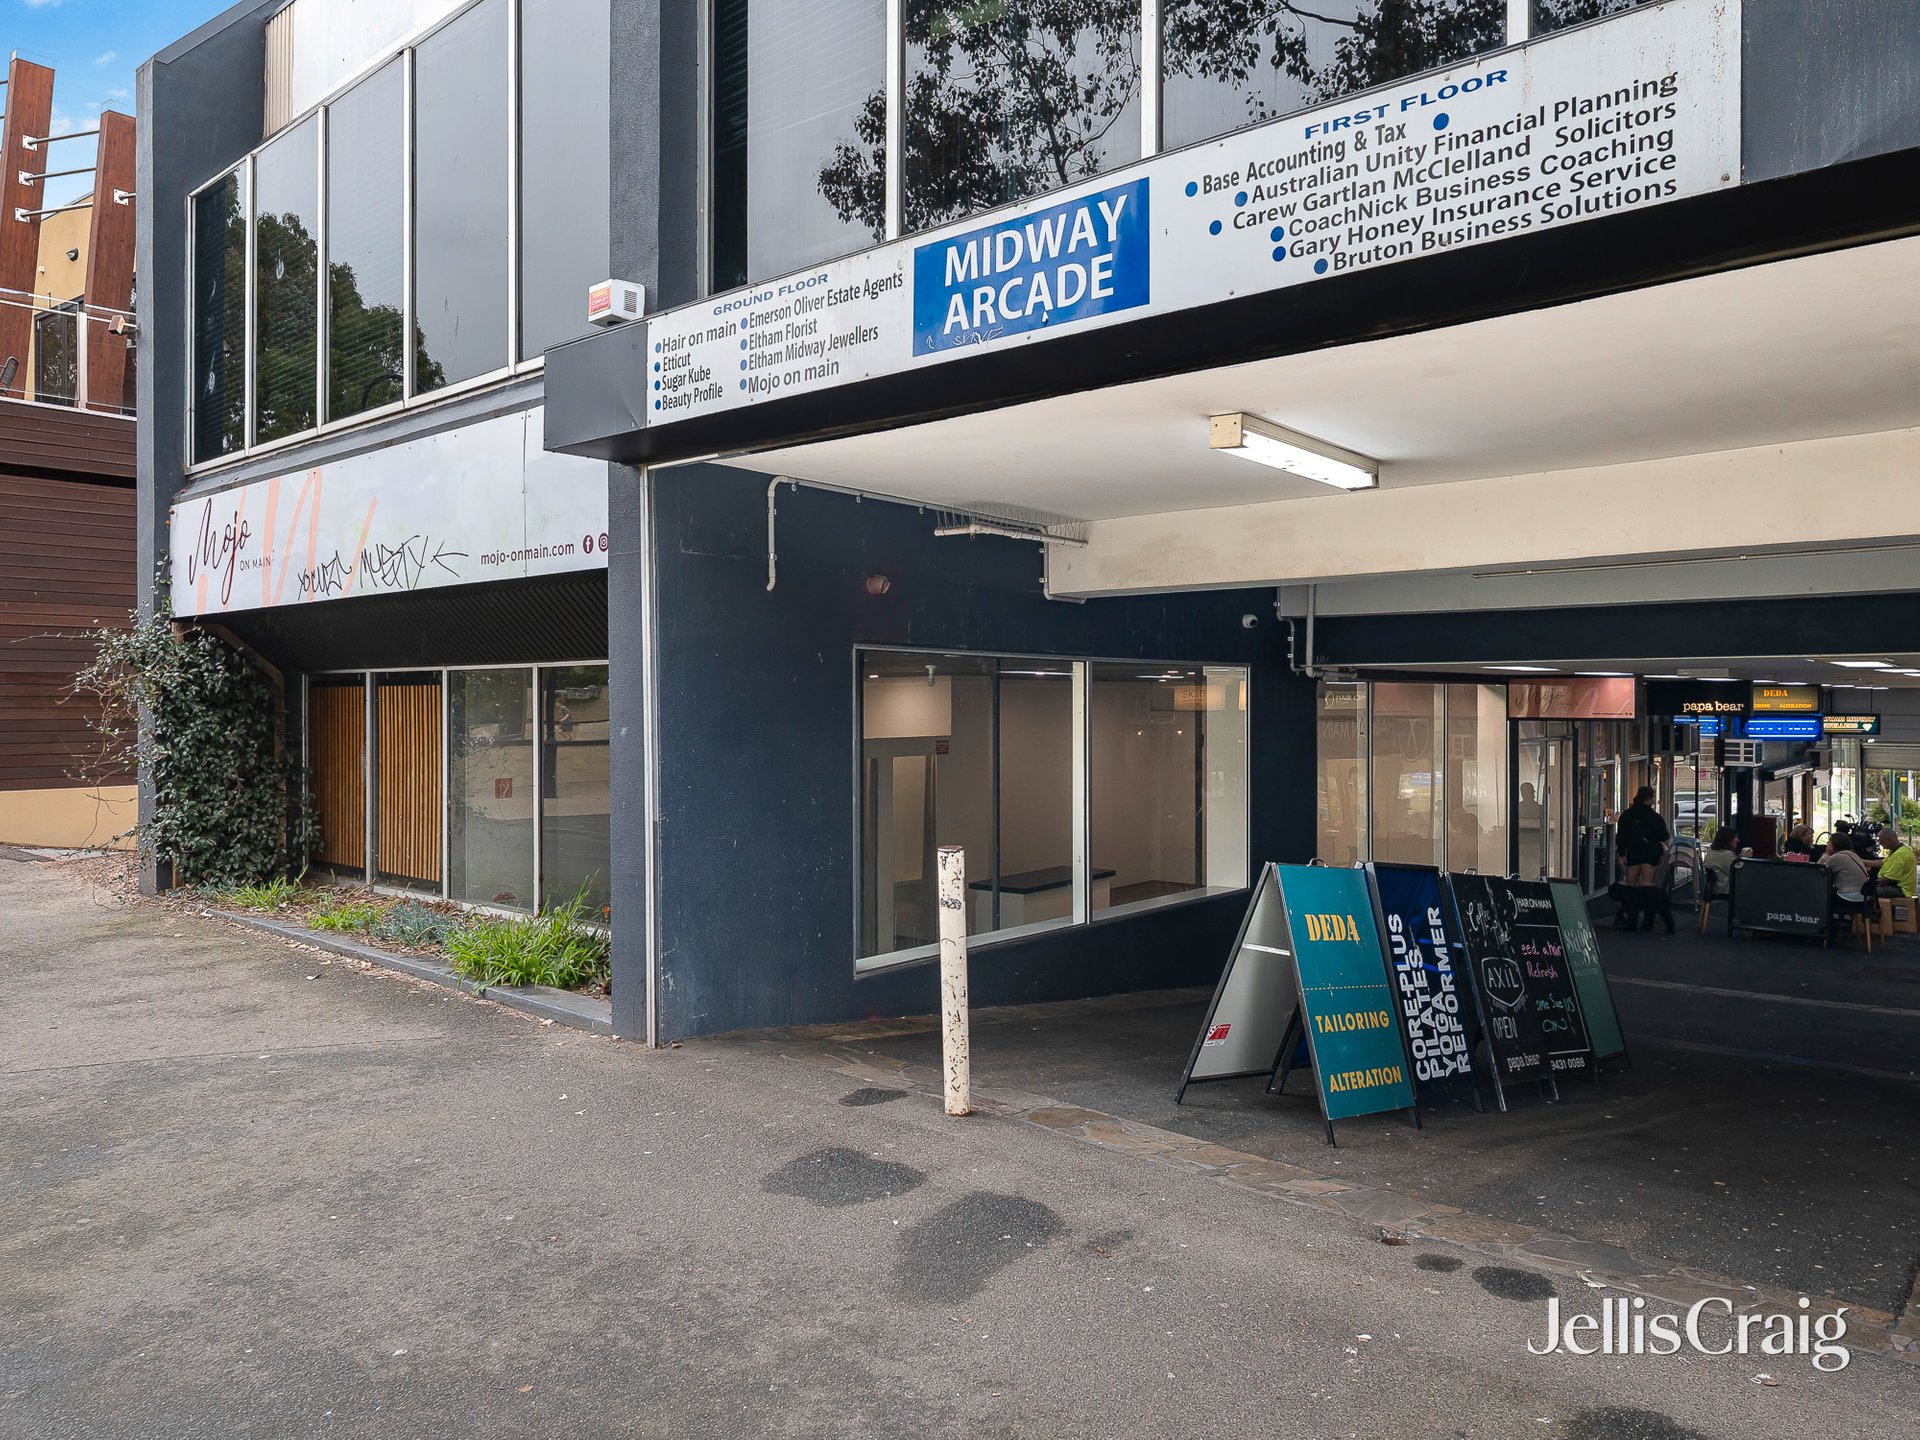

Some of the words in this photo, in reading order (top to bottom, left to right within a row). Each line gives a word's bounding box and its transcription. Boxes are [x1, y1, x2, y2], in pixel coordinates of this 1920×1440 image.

[1304, 103, 1390, 140] FIRST
[1400, 69, 1508, 112] FLOOR
[1251, 162, 1359, 204] Australian
[1365, 143, 1428, 174] Unity
[1433, 105, 1546, 156] Financial
[1553, 71, 1679, 123] Planning
[1202, 169, 1240, 196] Base
[1245, 139, 1346, 184] Accounting
[1353, 130, 1368, 152] &
[1374, 122, 1407, 147] Tax
[1233, 202, 1298, 230] Carew
[1302, 178, 1386, 213] Gartlan
[1393, 134, 1531, 190] McClelland
[1555, 101, 1677, 148] Solicitors
[1288, 193, 1408, 237] CoachNick
[1416, 166, 1531, 208] Business
[1539, 128, 1675, 176] Coaching
[1289, 233, 1341, 260] Gary
[1347, 214, 1424, 246] Honey
[1432, 182, 1562, 227] Insurance
[1569, 153, 1677, 194] Service
[1333, 239, 1413, 272] Bruton
[1421, 212, 1532, 251] Business
[1540, 178, 1678, 225] Solutions
[944, 193, 1128, 288] MIDWAY
[713, 290, 774, 316] GROUND
[778, 273, 829, 298] FLOOR
[749, 304, 792, 329] Emerson
[794, 295, 825, 317] Oliver
[827, 284, 861, 308] Estate
[863, 272, 903, 300] Agents
[942, 252, 1115, 336] ARCADE
[662, 334, 686, 354] Hair
[688, 331, 703, 347] on
[706, 320, 737, 342] main
[749, 328, 783, 351] Eltham
[785, 317, 818, 341] Florist
[749, 349, 783, 371] Eltham
[785, 338, 826, 362] Midway
[828, 324, 879, 352] Jewellers
[662, 374, 687, 392] Sugar
[688, 365, 711, 385] Kube
[663, 352, 692, 373] Etticut
[748, 372, 780, 395] Mojo
[784, 369, 801, 386] on
[804, 358, 840, 382] main
[662, 392, 693, 411] Beauty
[694, 382, 723, 403] Profile
[239, 559, 250, 572] ON
[252, 555, 272, 570] MAIN
[480, 542, 575, 566] mojo-onmain.com
[1682, 702, 1714, 713] papa
[1714, 700, 1745, 712] bear
[1763, 689, 1789, 697] DEDA
[1304, 913, 1361, 942] DEDA
[1766, 912, 1793, 922] papa
[1794, 913, 1820, 924] bear
[1427, 906, 1472, 1074] REFORMER
[1315, 1010, 1390, 1034] TAILORING
[1408, 946, 1446, 1079] PILATES
[1493, 1016, 1518, 1039] OPEN
[1431, 990, 1457, 1078] YOGA
[1329, 1065, 1403, 1093] ALTERATION
[1506, 1055, 1526, 1072] papa
